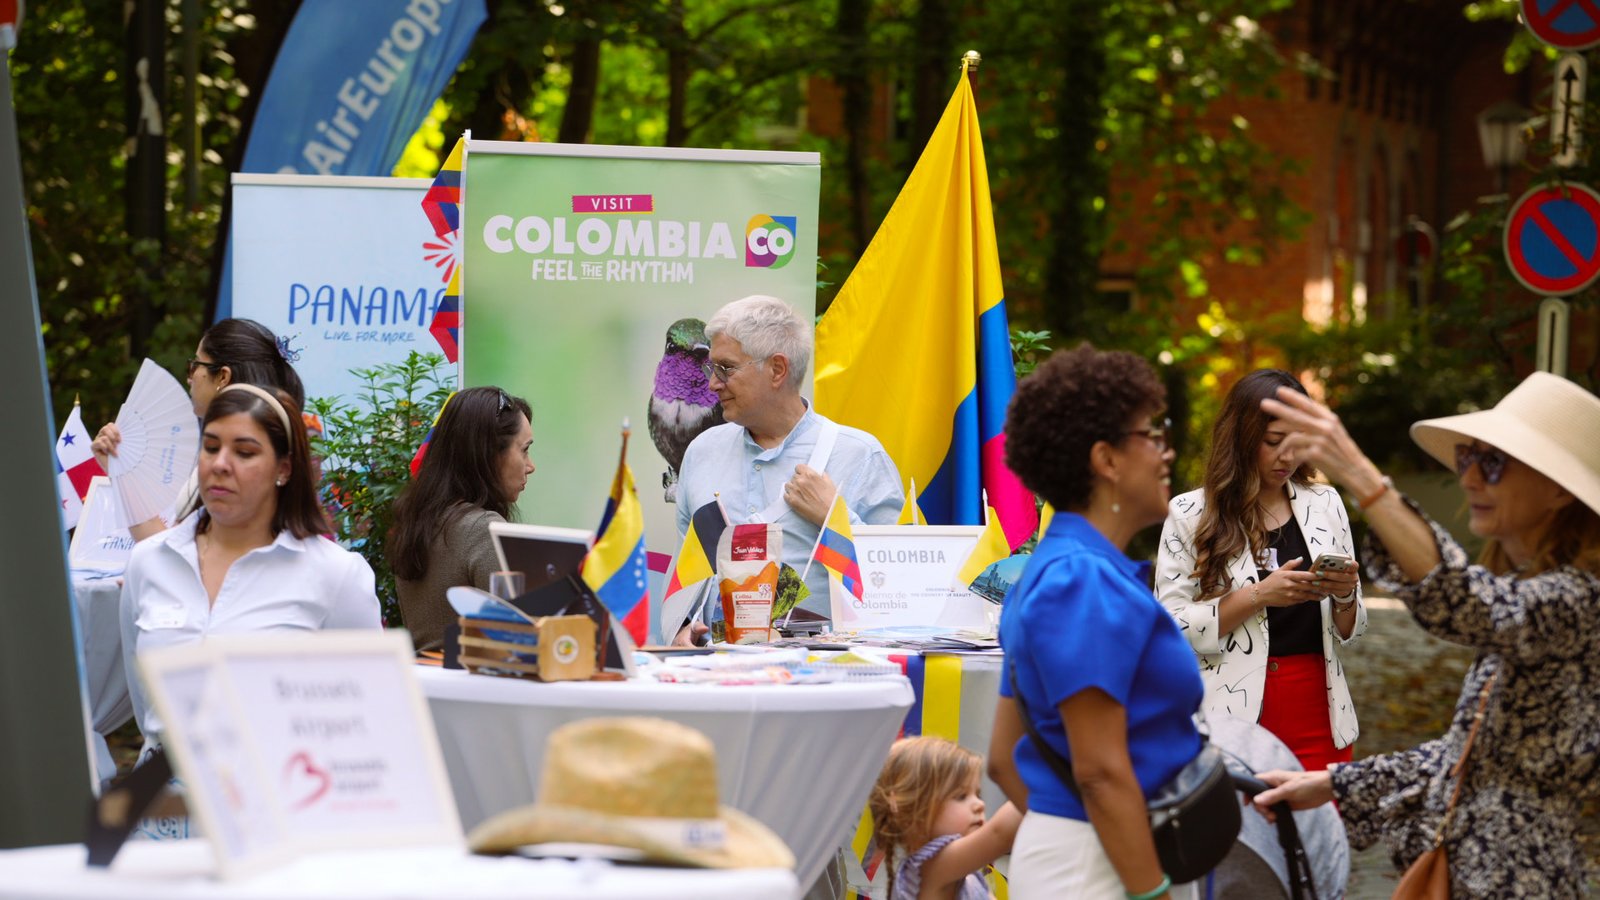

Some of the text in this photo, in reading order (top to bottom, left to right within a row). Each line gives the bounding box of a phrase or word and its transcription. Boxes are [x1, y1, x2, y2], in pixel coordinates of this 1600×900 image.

[302, 0, 453, 176] AirEurop
[591, 197, 633, 211] VISIT
[483, 214, 794, 259] COLOMBIA CO
[532, 258, 694, 284] FEEL THE RHYTHM
[323, 330, 416, 345] LIVE FOR MORE
[867, 549, 946, 563] COLOMBIA
[853, 599, 908, 609] Colombia
